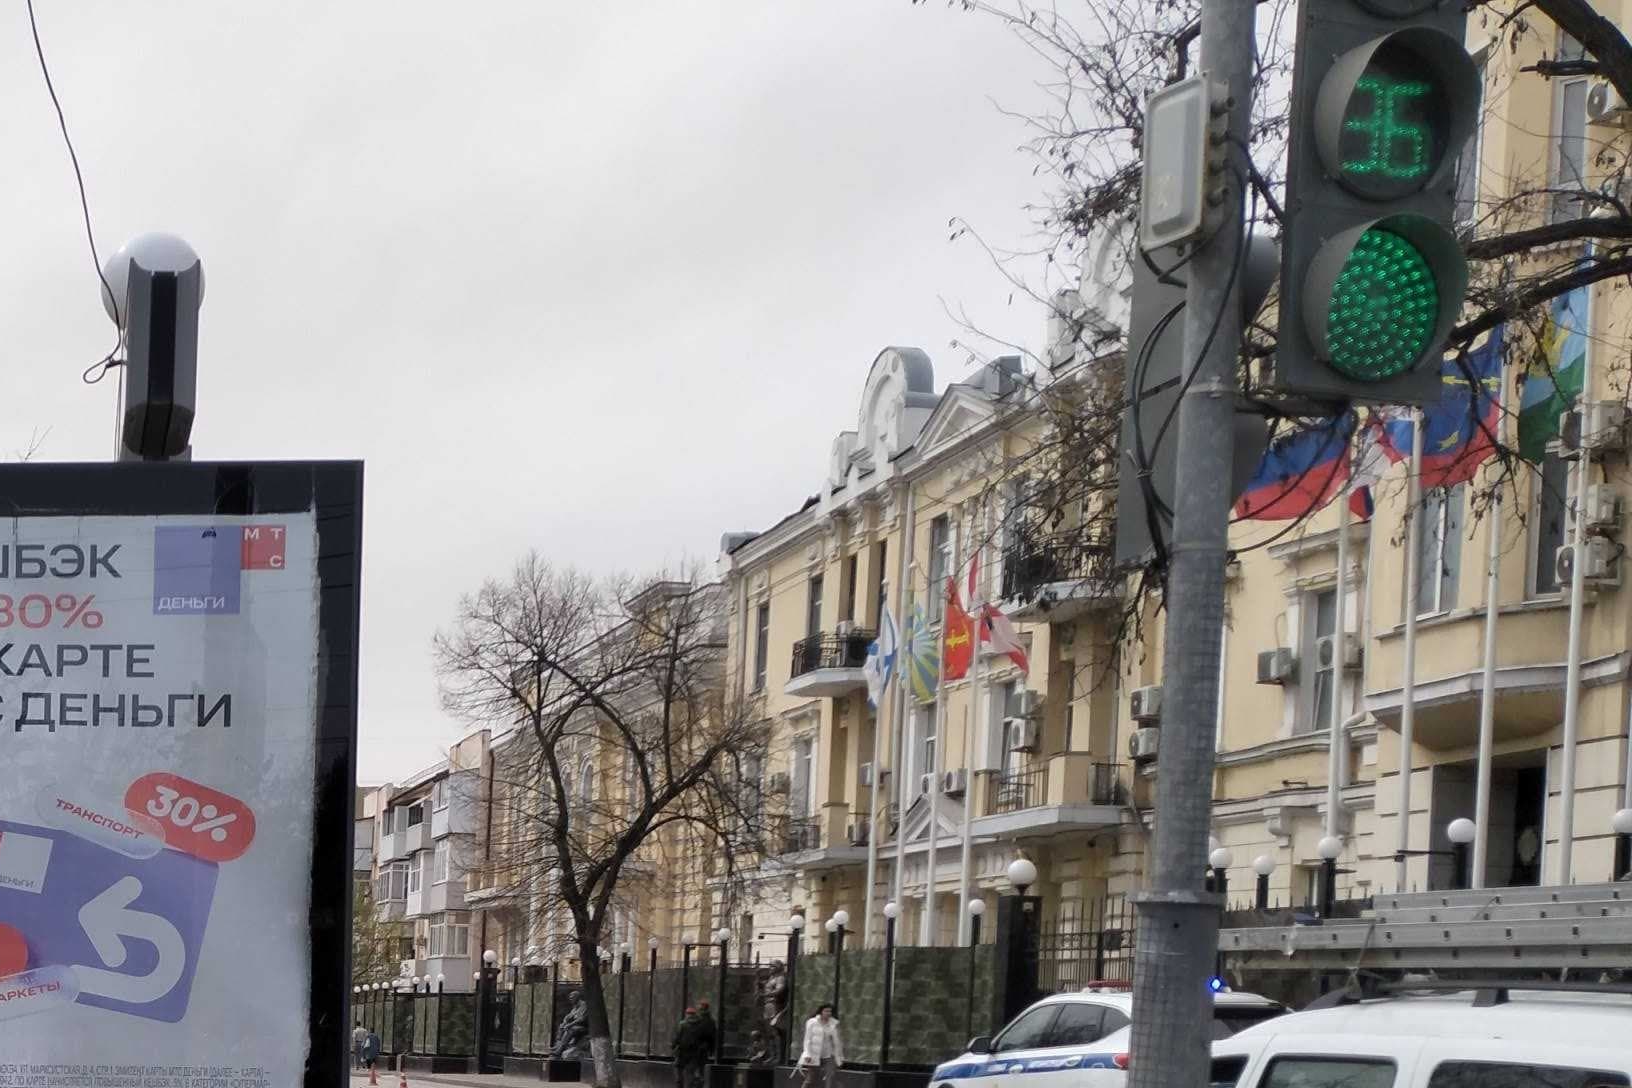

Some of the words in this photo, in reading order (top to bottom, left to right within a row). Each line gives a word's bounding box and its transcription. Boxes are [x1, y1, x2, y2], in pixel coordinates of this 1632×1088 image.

[157, 596, 226, 611] ДЕНЬГИ
[14, 692, 232, 733] ДЕНЬГИ
[55, 798, 145, 841] ТРАНСПОРТ
[146, 784, 228, 843] 30%
